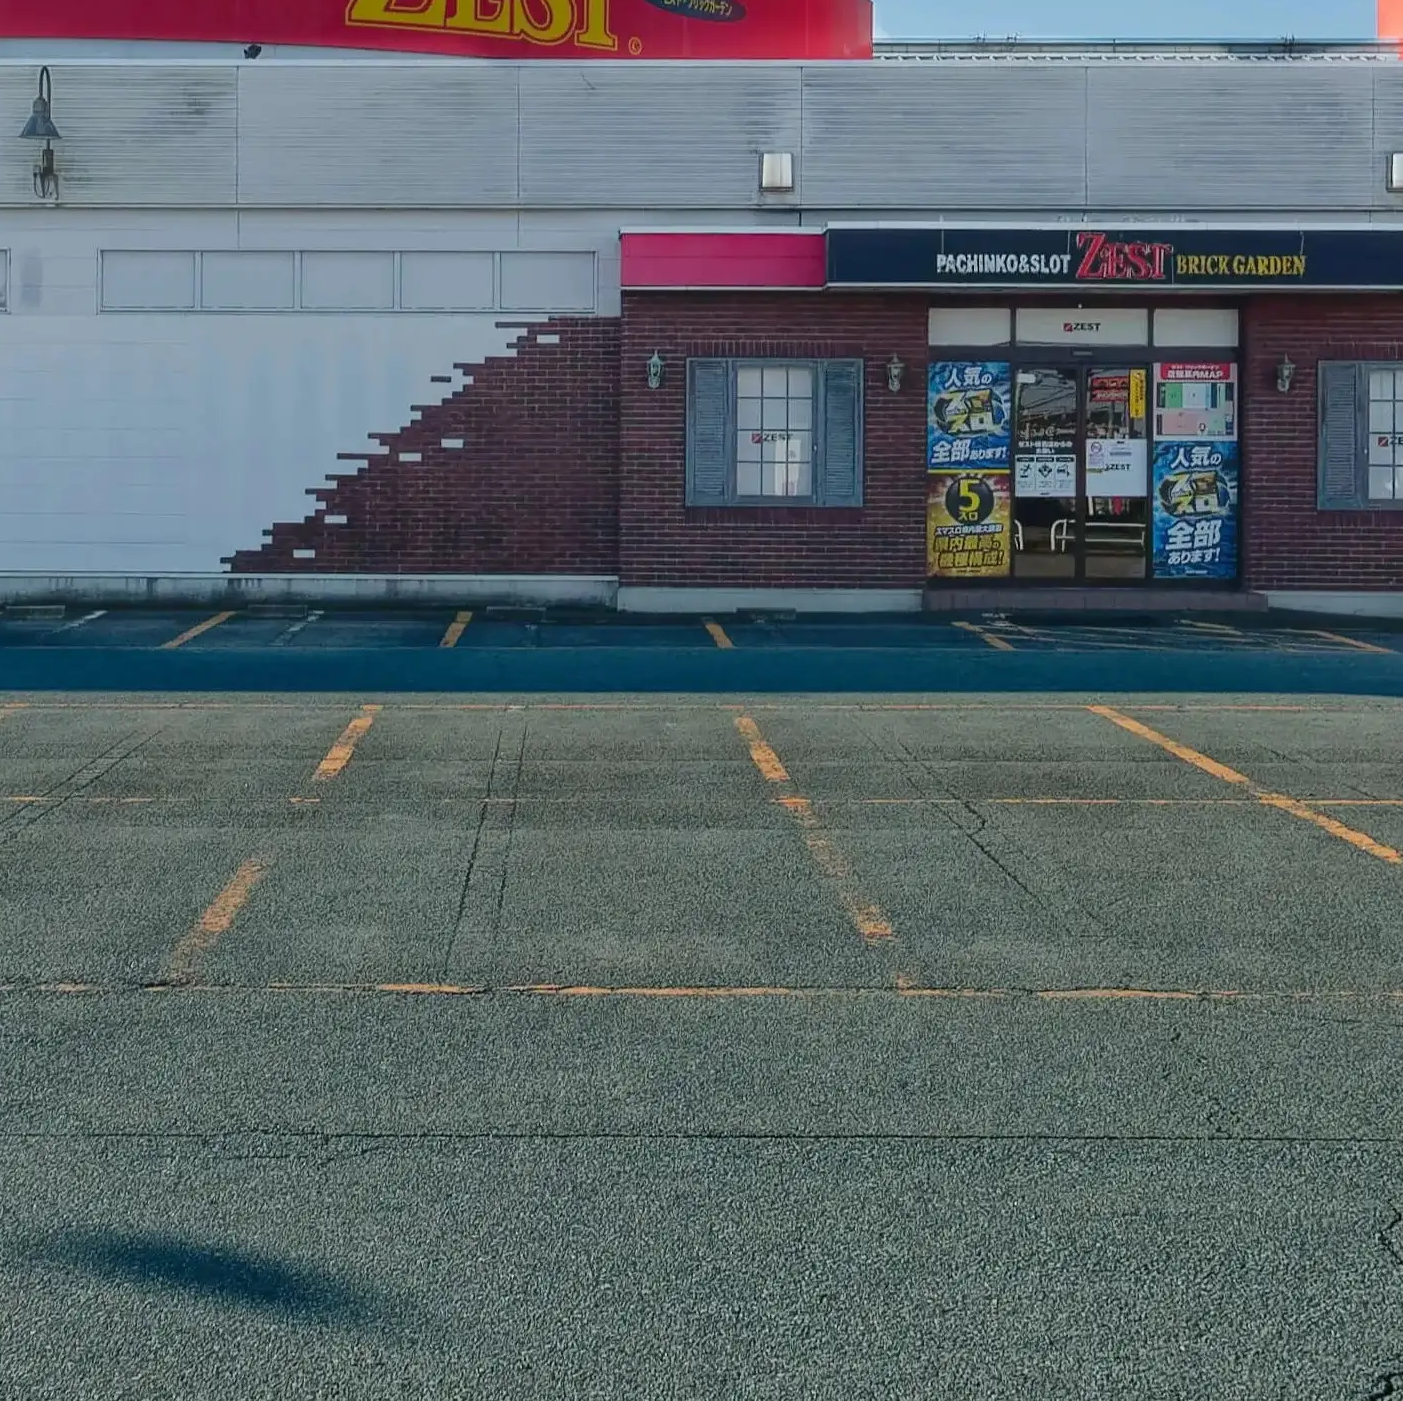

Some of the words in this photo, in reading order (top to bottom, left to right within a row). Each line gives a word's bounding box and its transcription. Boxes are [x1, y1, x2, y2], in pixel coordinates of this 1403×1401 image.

[937, 254, 1071, 274] PACHINKO&SLOT
[1076, 232, 1174, 280] ZEST
[1177, 255, 1230, 275] BRICK
[1233, 255, 1306, 276] GARDEN
[1073, 322, 1101, 331] ZEST
[944, 366, 992, 388] 人気の
[763, 433, 794, 442] ZEST
[1170, 445, 1222, 468] 人気の
[958, 479, 981, 512] 5
[958, 512, 978, 521] スロ
[1165, 519, 1222, 550] 全部
